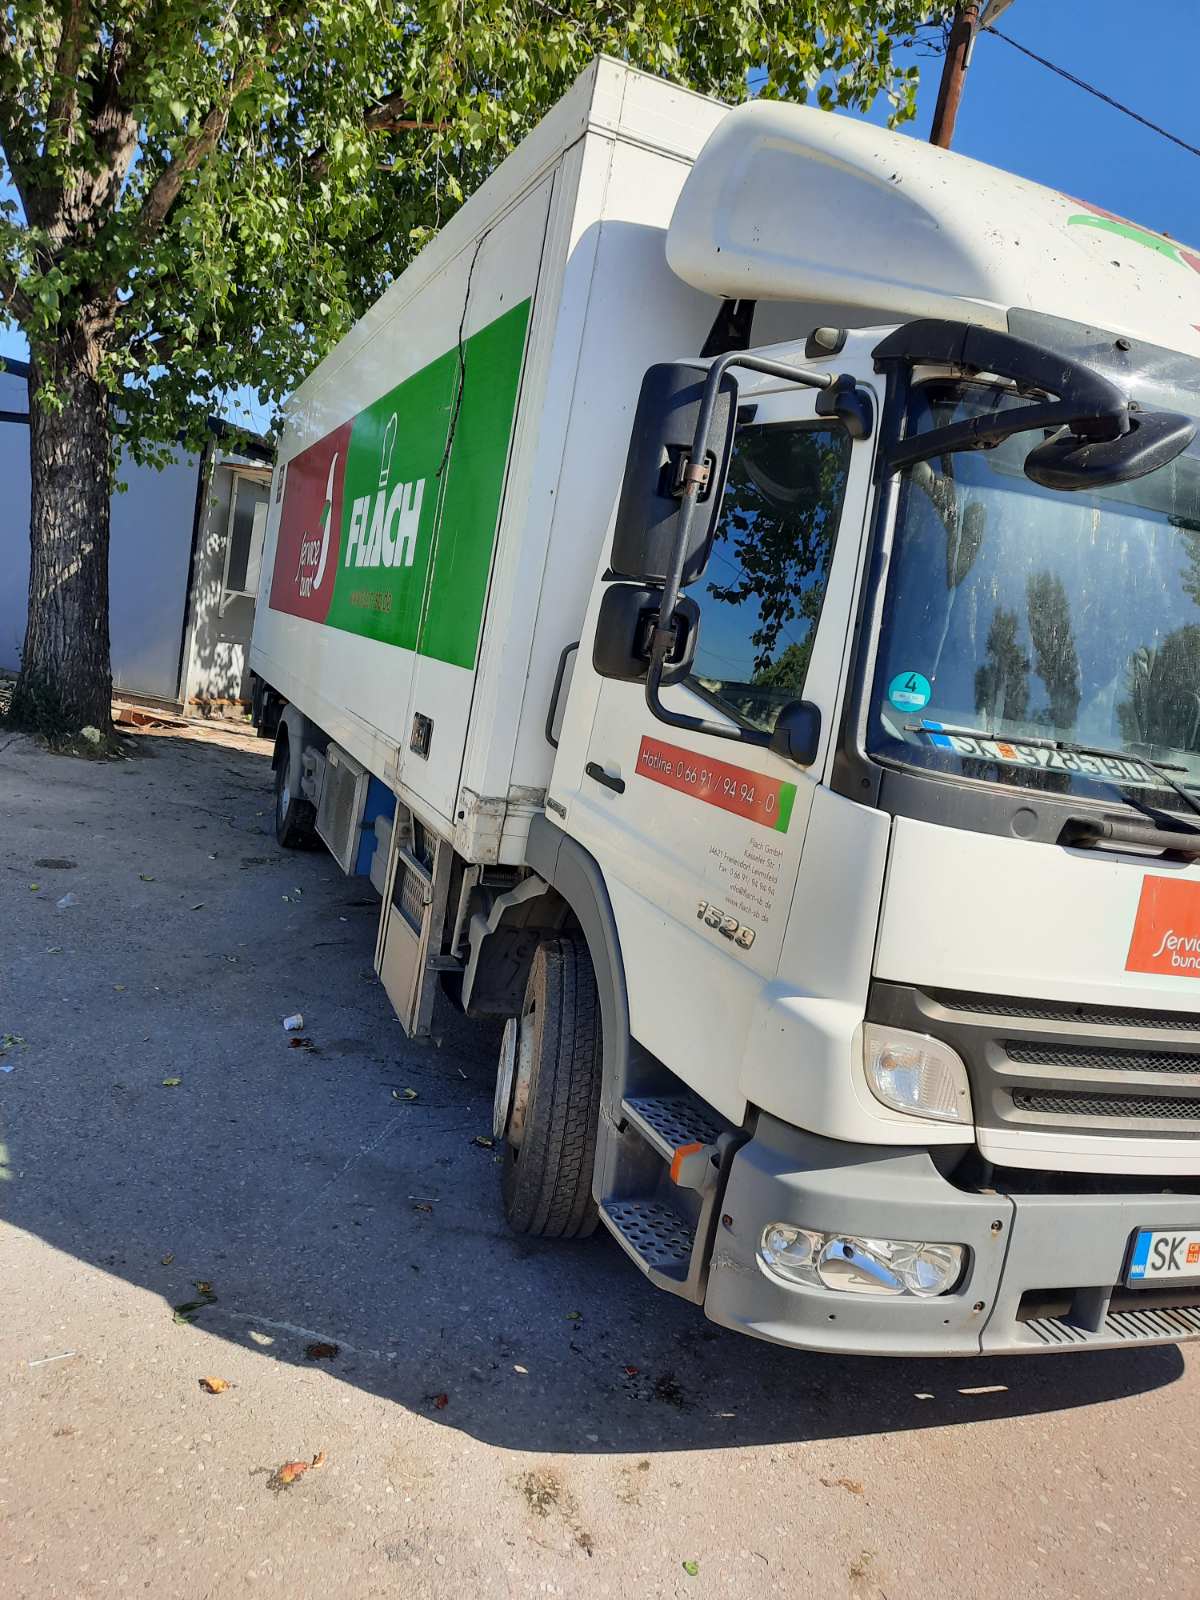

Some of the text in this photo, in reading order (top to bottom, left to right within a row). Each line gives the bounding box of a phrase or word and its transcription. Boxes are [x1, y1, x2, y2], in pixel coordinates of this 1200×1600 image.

[904, 673, 917, 692] 4
[641, 751, 673, 775] Hotline:
[676, 761, 684, 778] 0
[684, 767, 697, 784] 66
[699, 769, 713, 790] 91
[723, 777, 737, 797] 94
[740, 783, 755, 804] 94
[765, 793, 775, 813] 0
[1151, 1236, 1186, 1271] SK
